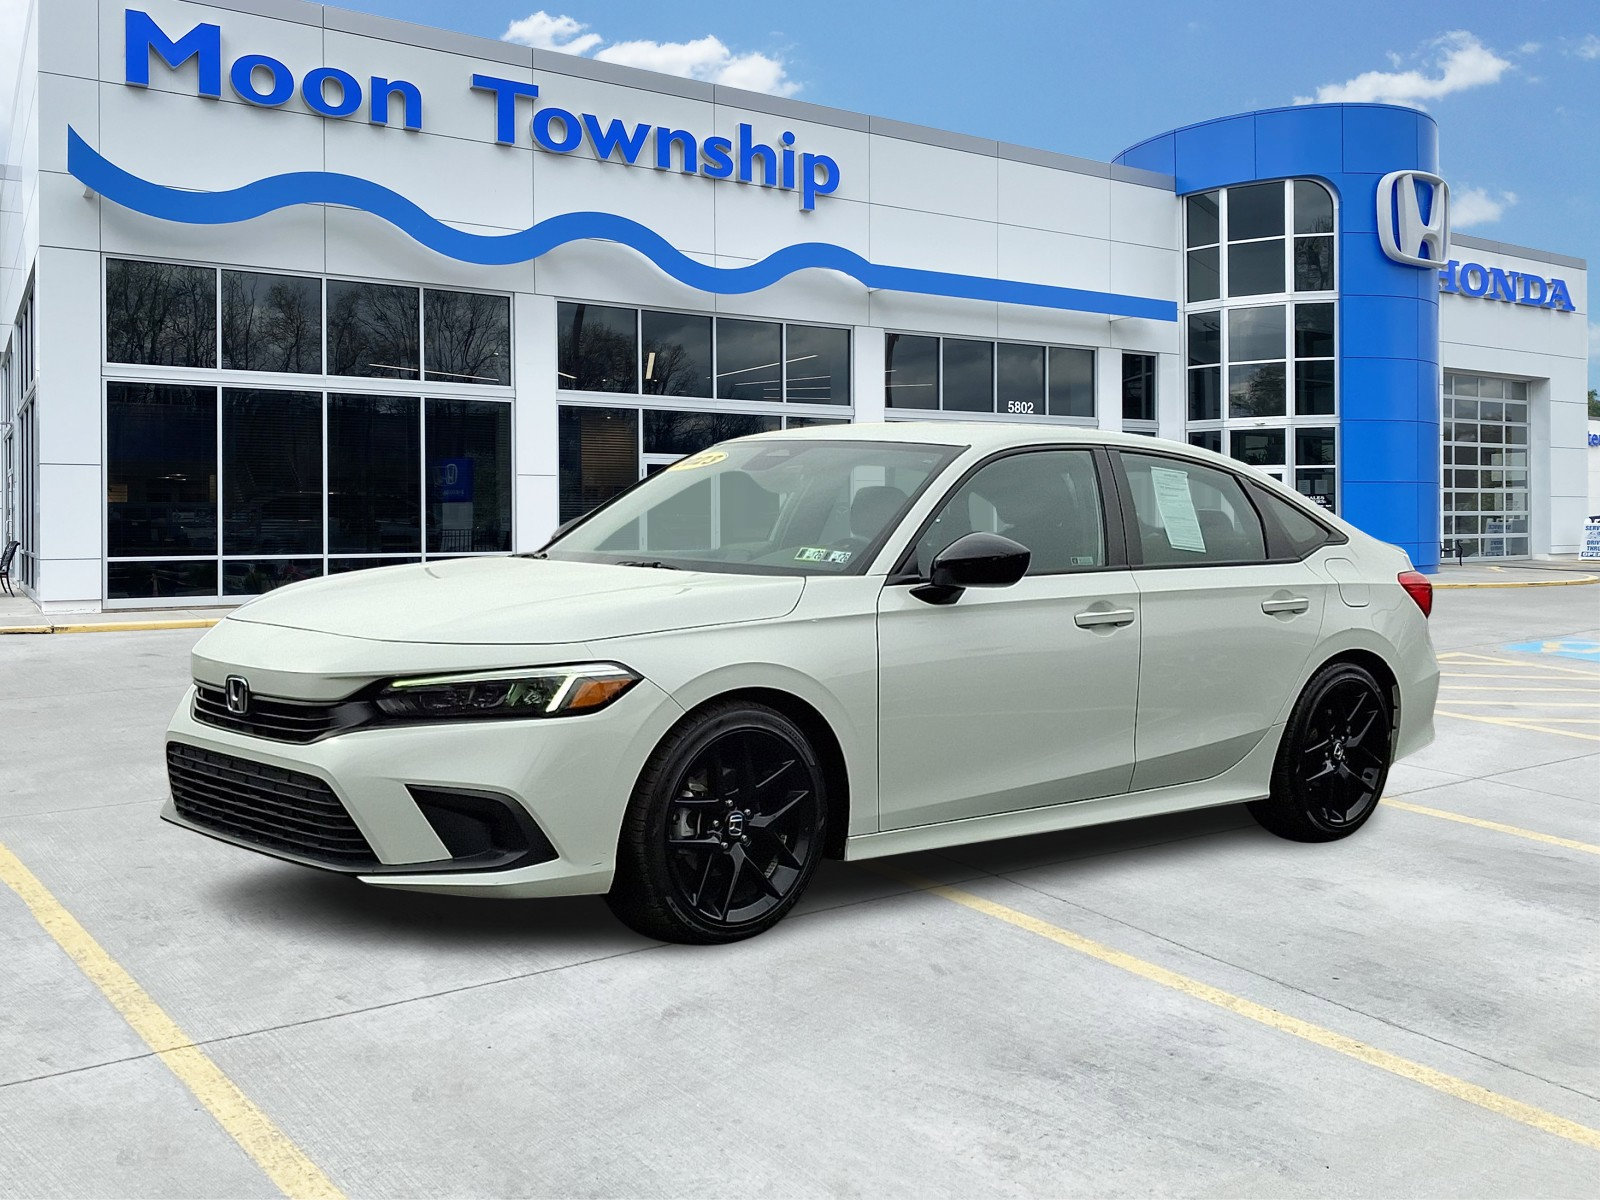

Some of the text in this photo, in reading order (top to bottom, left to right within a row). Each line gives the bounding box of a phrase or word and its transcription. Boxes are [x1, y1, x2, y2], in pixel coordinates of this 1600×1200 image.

[125, 9, 841, 212] Moon Township
[1007, 400, 1035, 414] 5802
